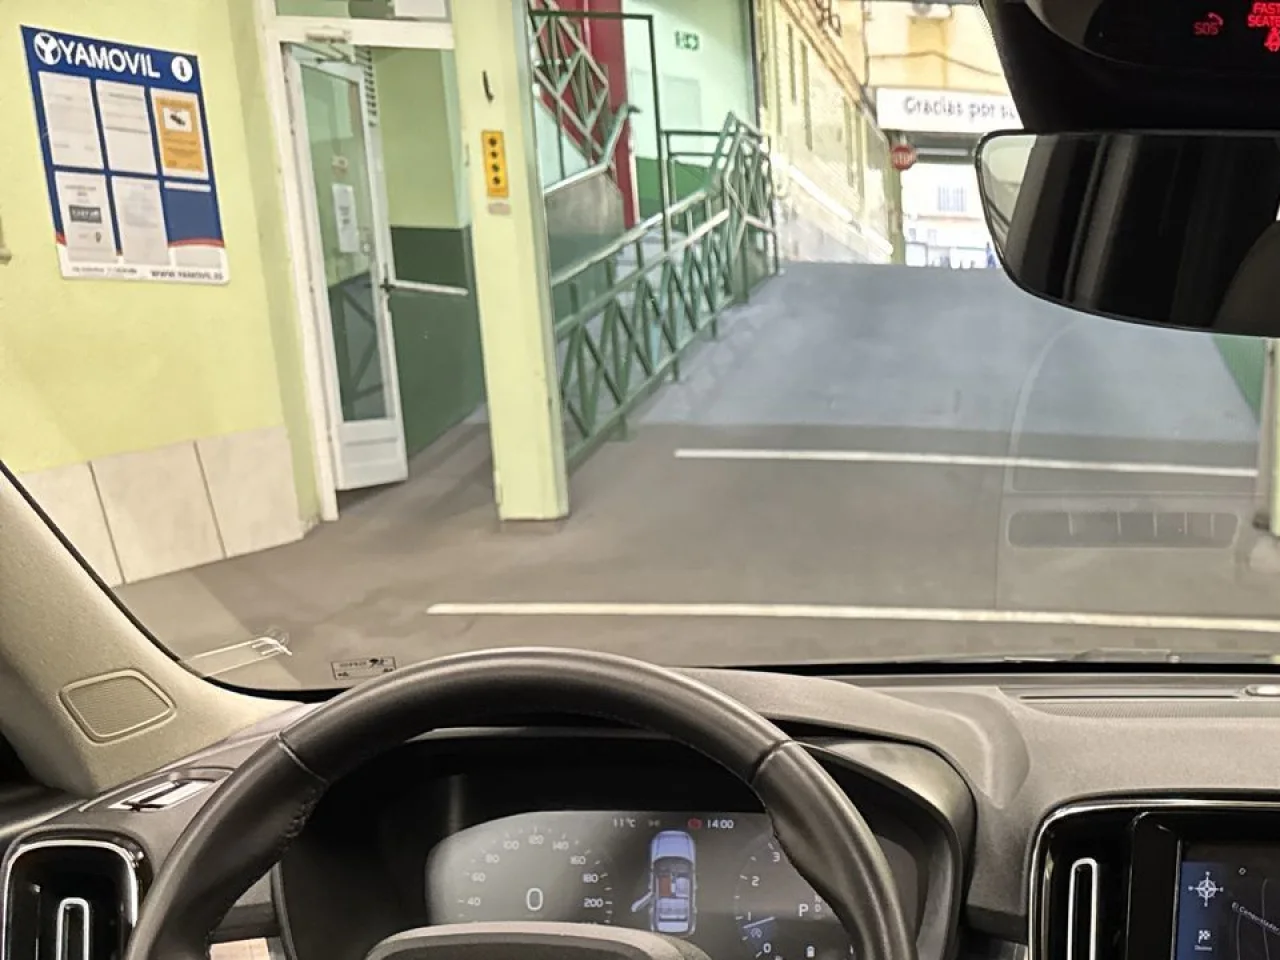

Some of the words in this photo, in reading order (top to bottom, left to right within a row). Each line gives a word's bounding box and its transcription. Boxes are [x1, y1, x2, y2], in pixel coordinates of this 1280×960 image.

[1194, 22, 1219, 36] SOS
[58, 39, 161, 79] YAMOVIL
[902, 95, 964, 117] Gracias
[967, 102, 996, 124] por
[772, 851, 781, 863] 3
[752, 875, 761, 887] 2
[525, 886, 544, 912] 0
[584, 898, 605, 908] 200
[798, 903, 809, 917] P
[763, 943, 772, 953] 0
